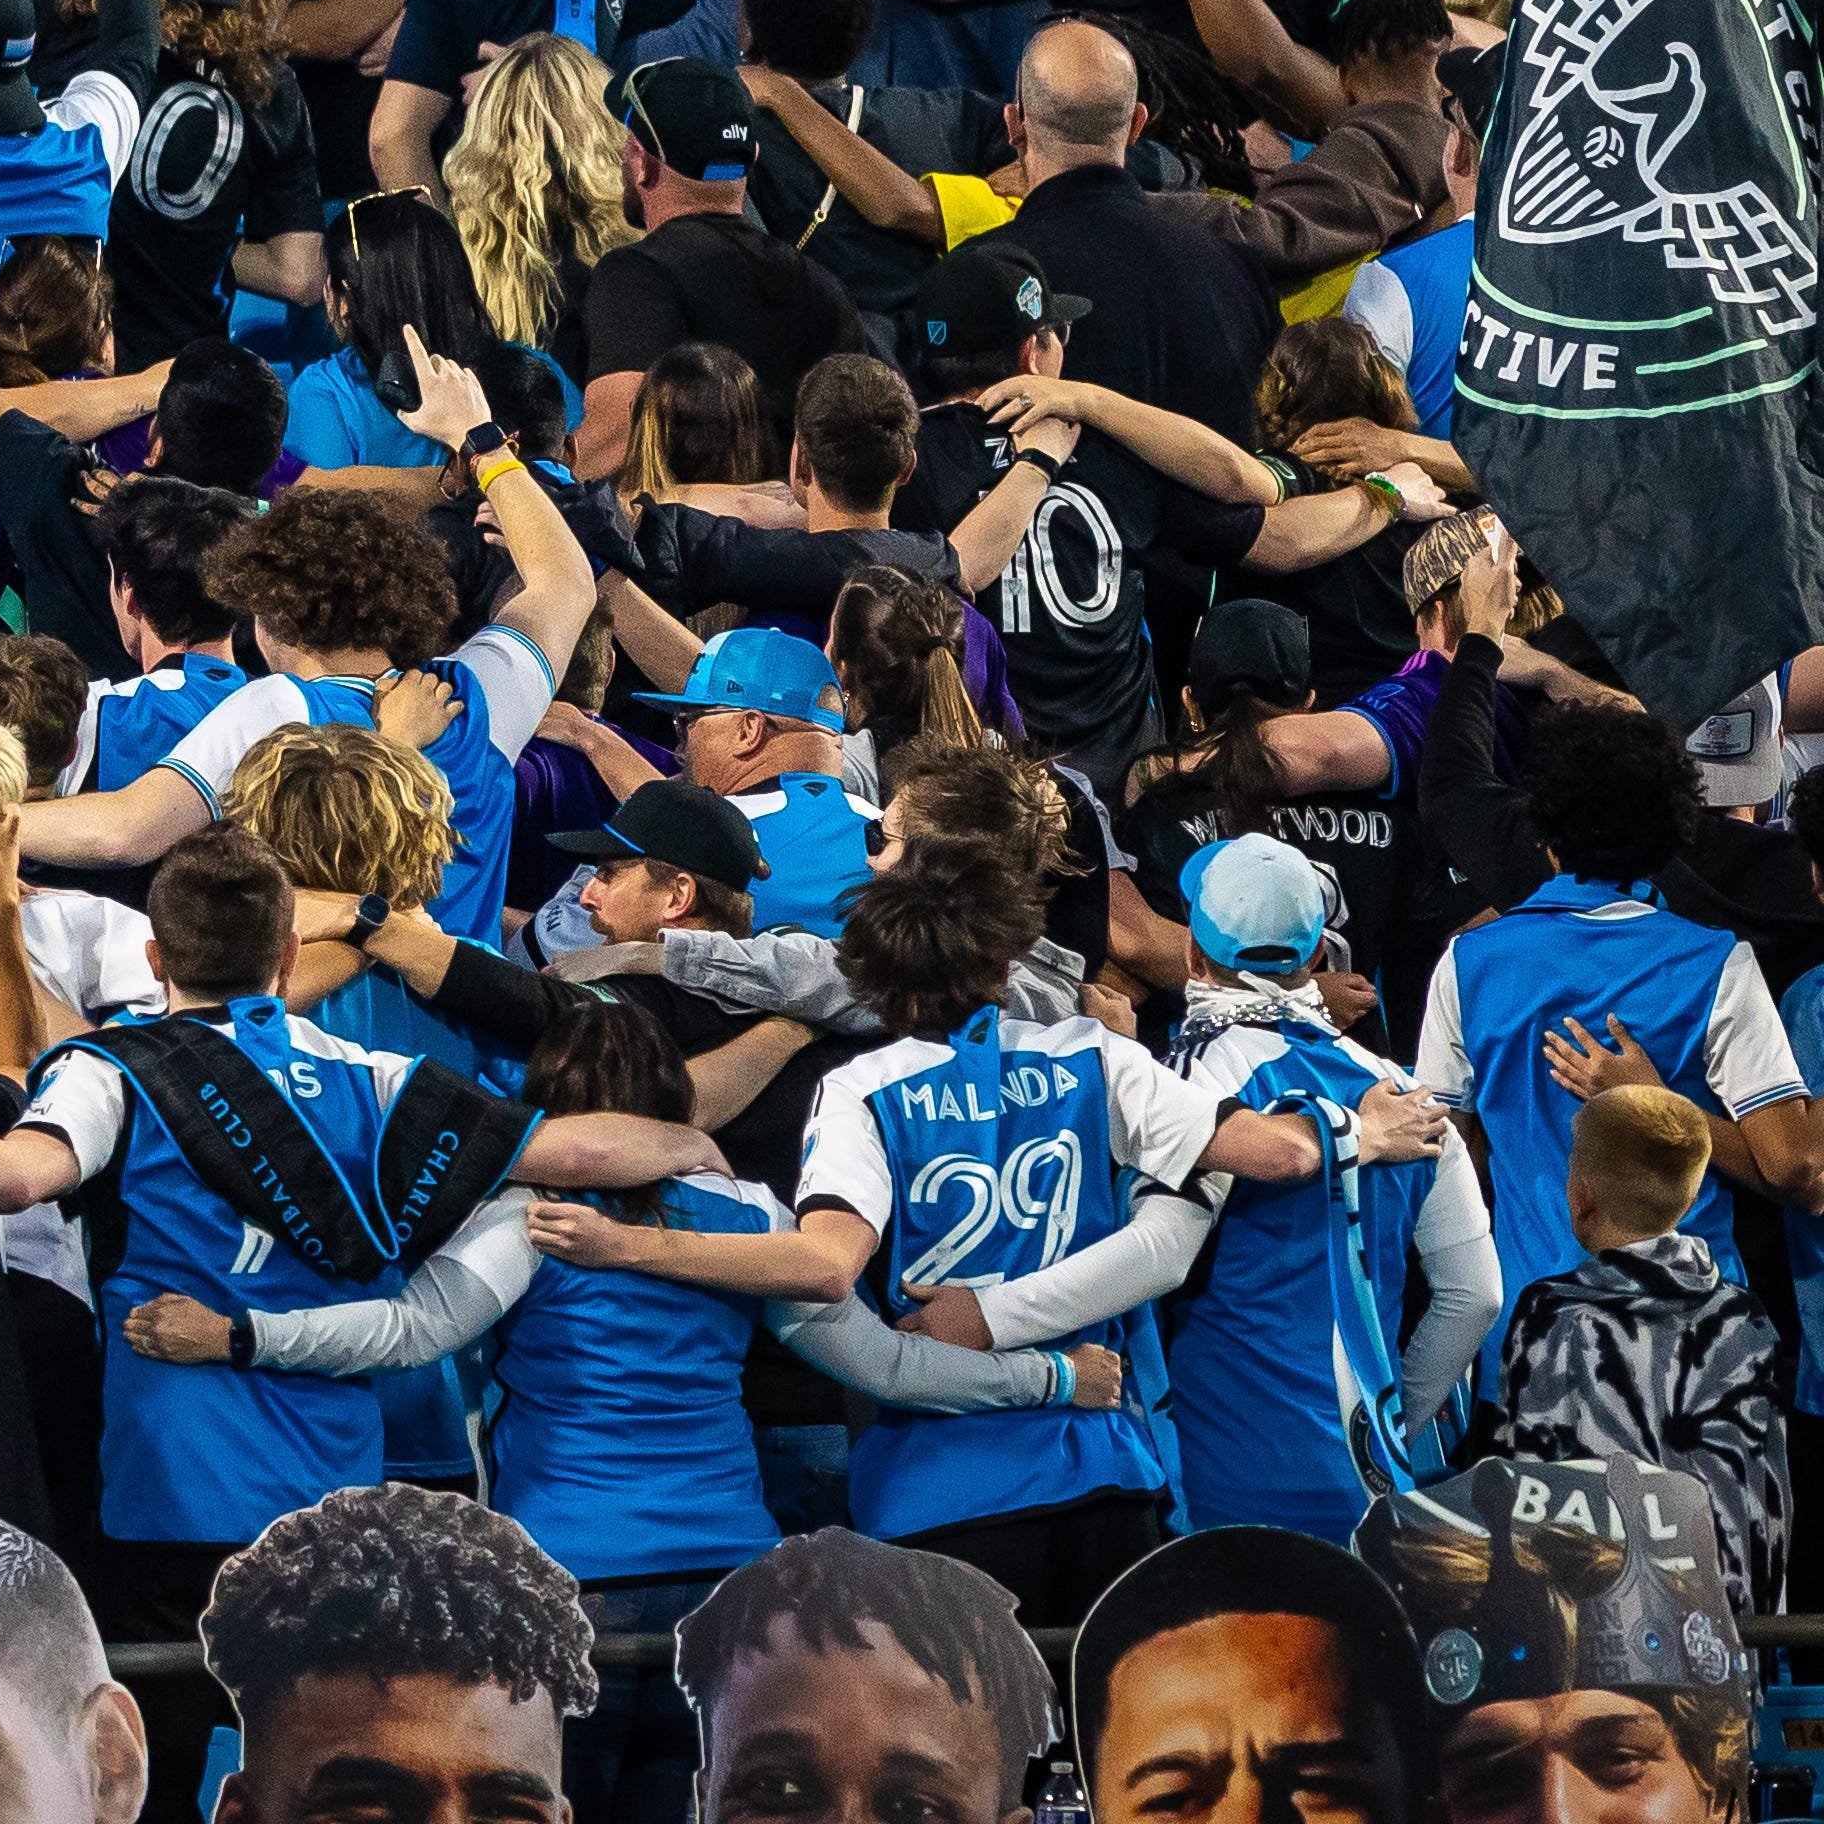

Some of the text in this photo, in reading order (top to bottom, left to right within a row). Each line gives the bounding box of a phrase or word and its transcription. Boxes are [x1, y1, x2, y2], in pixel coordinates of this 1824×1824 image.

[722, 124, 748, 142] ally
[1182, 806, 1393, 849] WTWOOD
[199, 1082, 253, 1150] CLUB
[901, 1065, 1080, 1122] MALNDA
[902, 1128, 1083, 1288] 29
